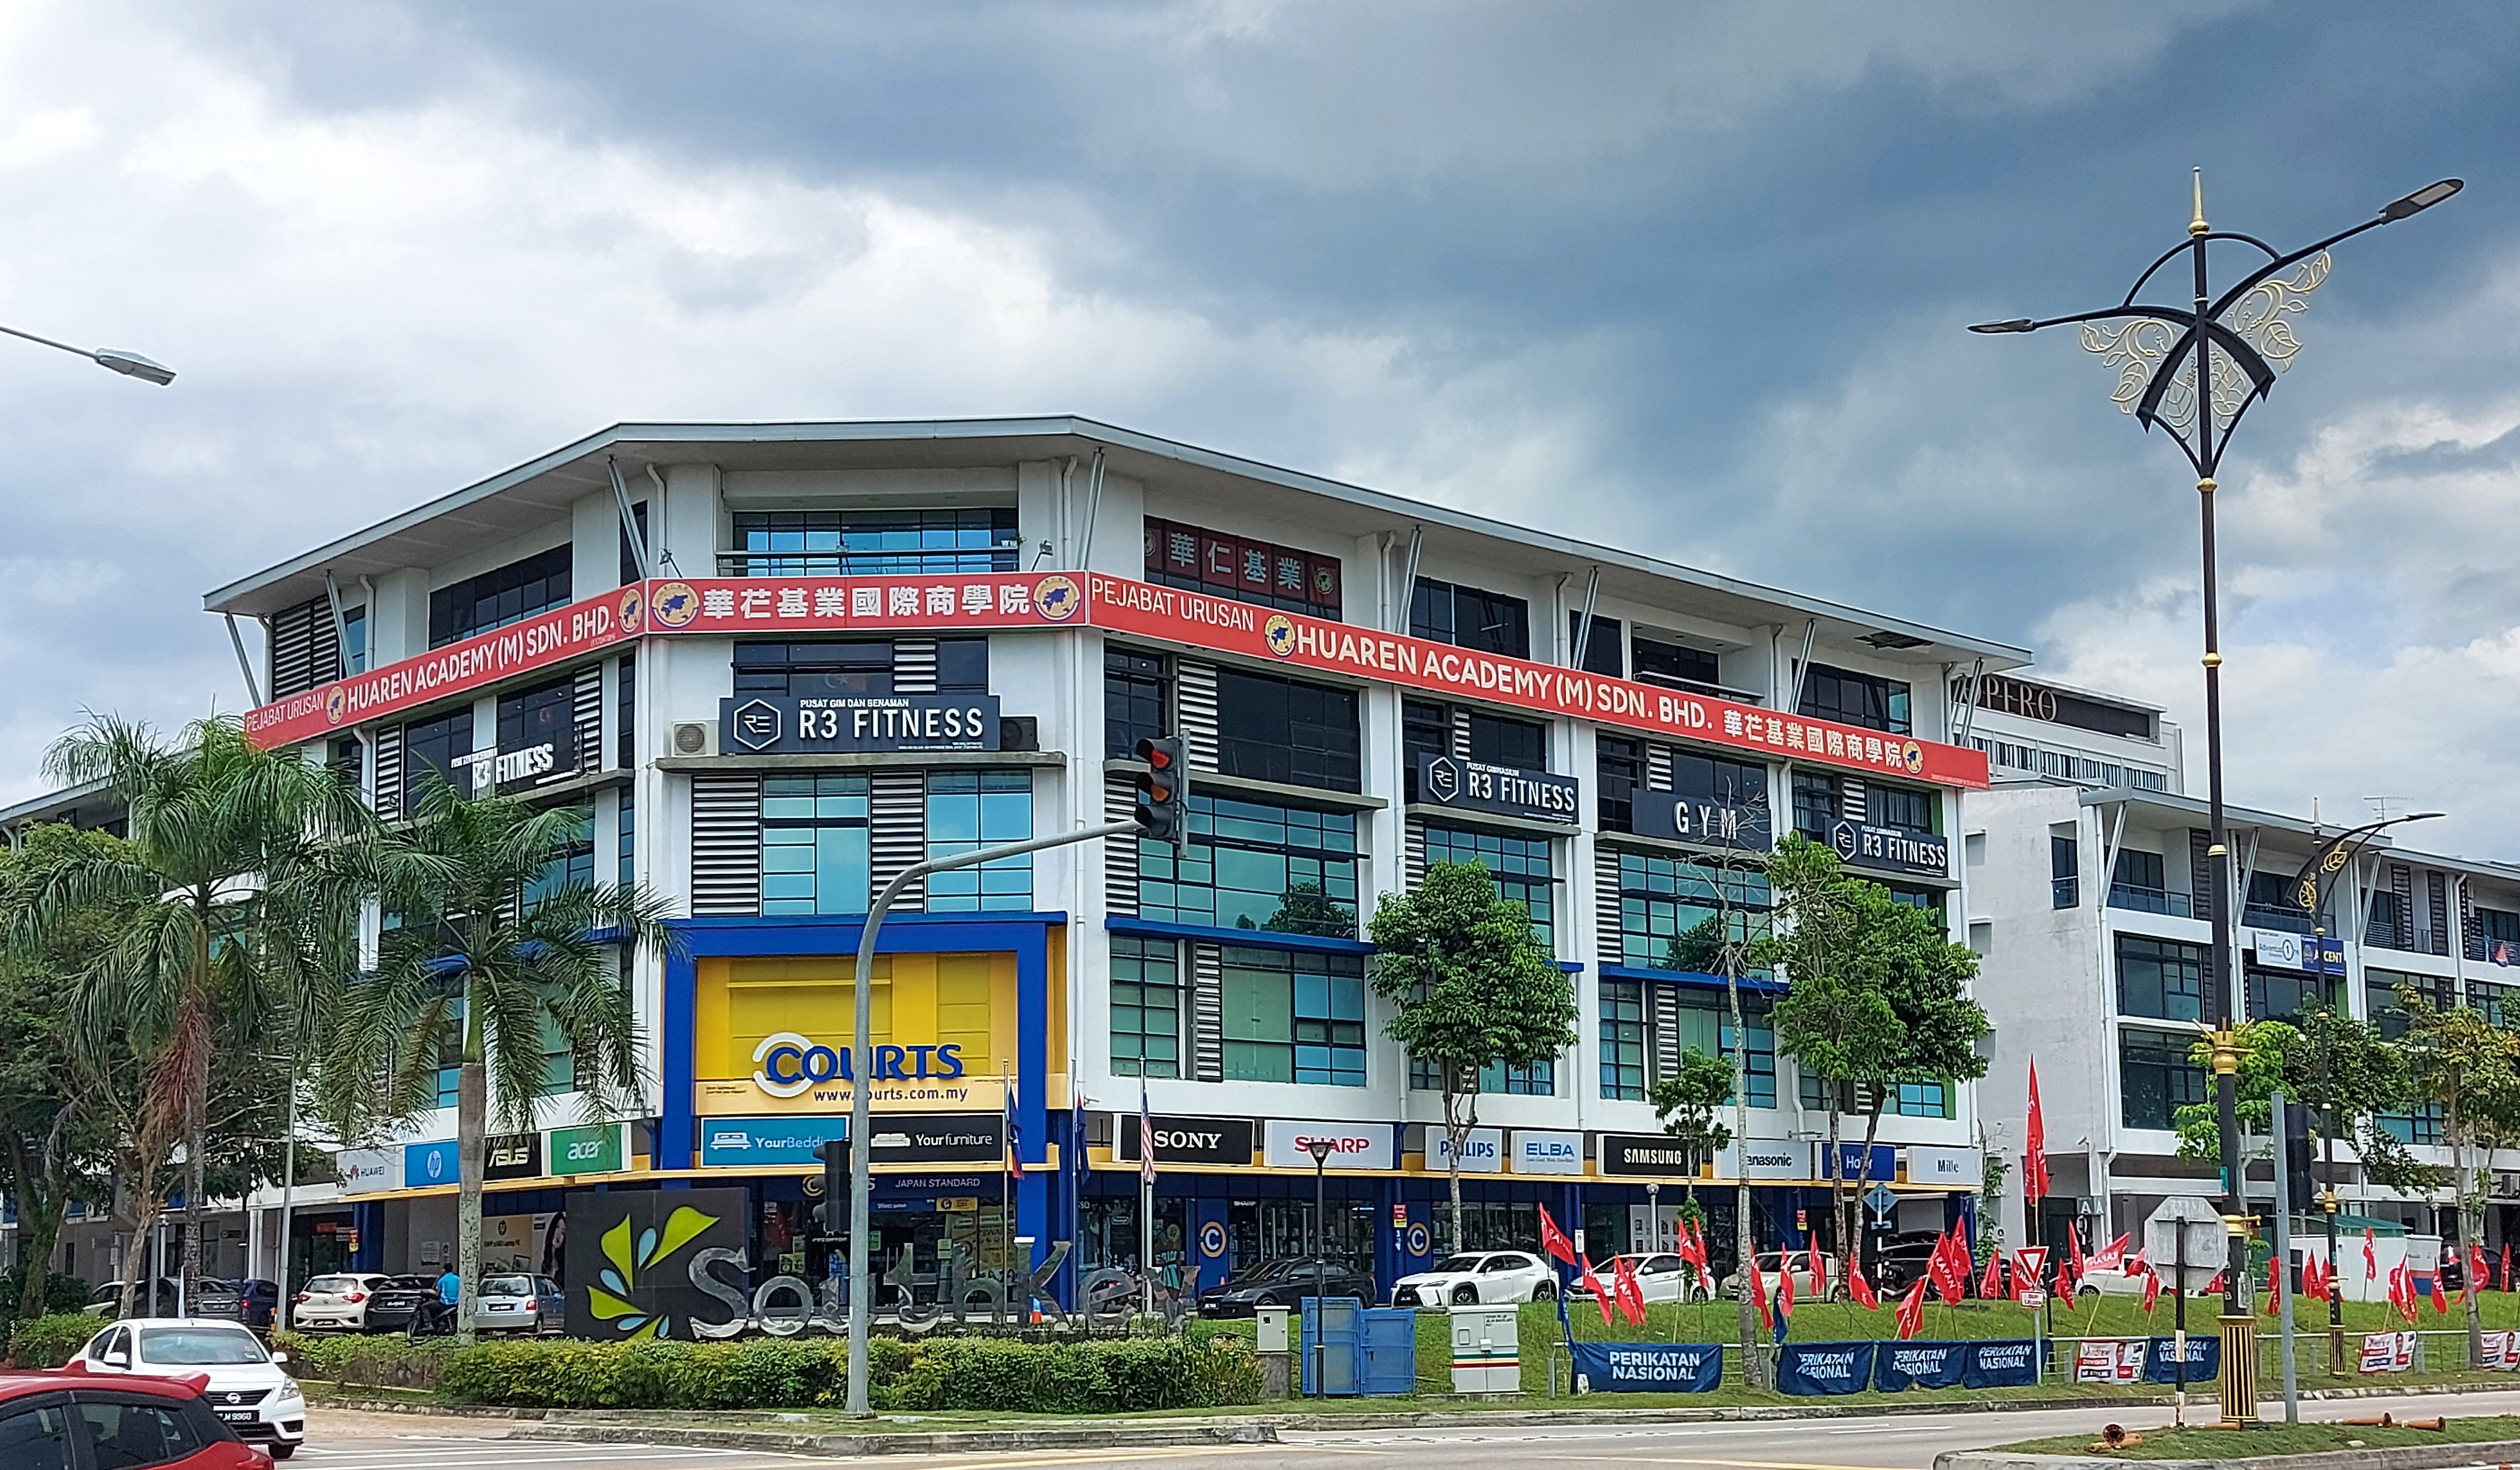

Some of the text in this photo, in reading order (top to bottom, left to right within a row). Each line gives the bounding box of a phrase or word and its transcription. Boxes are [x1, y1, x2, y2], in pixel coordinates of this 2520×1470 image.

[1170, 533, 1302, 591] 華仁基業
[1092, 577, 1253, 632] PEJABAT URUSAN
[348, 606, 615, 713] HUAREN ACADEMY (M) SDN. BHD.
[1298, 625, 1713, 729] HUAREN ACADEMY (M) SDN. BHD.
[800, 699, 909, 707] PUSAT GIM DAN SENAMAN
[246, 692, 323, 733] PEJABAT URUSAN
[800, 707, 983, 739] R3 FITNESS
[496, 743, 554, 783] FITNESS
[1469, 771, 1575, 811] R3 FITNESS
[1675, 801, 1736, 840] GYM
[1863, 834, 1946, 867] R3 FITNESS
[2313, 948, 2343, 964] ACENT
[766, 1044, 964, 1084] COURTS
[814, 1087, 968, 1102] www.urts.com.my
[755, 1135, 826, 1148] YourBeddi
[1154, 1131, 1221, 1149] SONY
[568, 1141, 603, 1160] acer
[1440, 1141, 1494, 1158] PILIPS
[1526, 1143, 1575, 1157] ELBA
[1624, 1148, 1682, 1165] SAMSUNG
[1747, 1152, 1792, 1167] anasonic
[361, 1166, 385, 1177] HUAWEI
[895, 1178, 980, 1188] JAPAN STANDARD
[1979, 1345, 2033, 1357] PERIKATAN
[2159, 1341, 2208, 1351] PERATAN
[1610, 1351, 1700, 1367] PERIKATAN
[1980, 1356, 2026, 1370] NASIONAL
[2159, 1350, 2205, 1362] NASNAL
[1612, 1366, 1697, 1381] NASIONAL
[1795, 1363, 1852, 1379] SIONAL
[1892, 1360, 1942, 1375] NSIONAL
